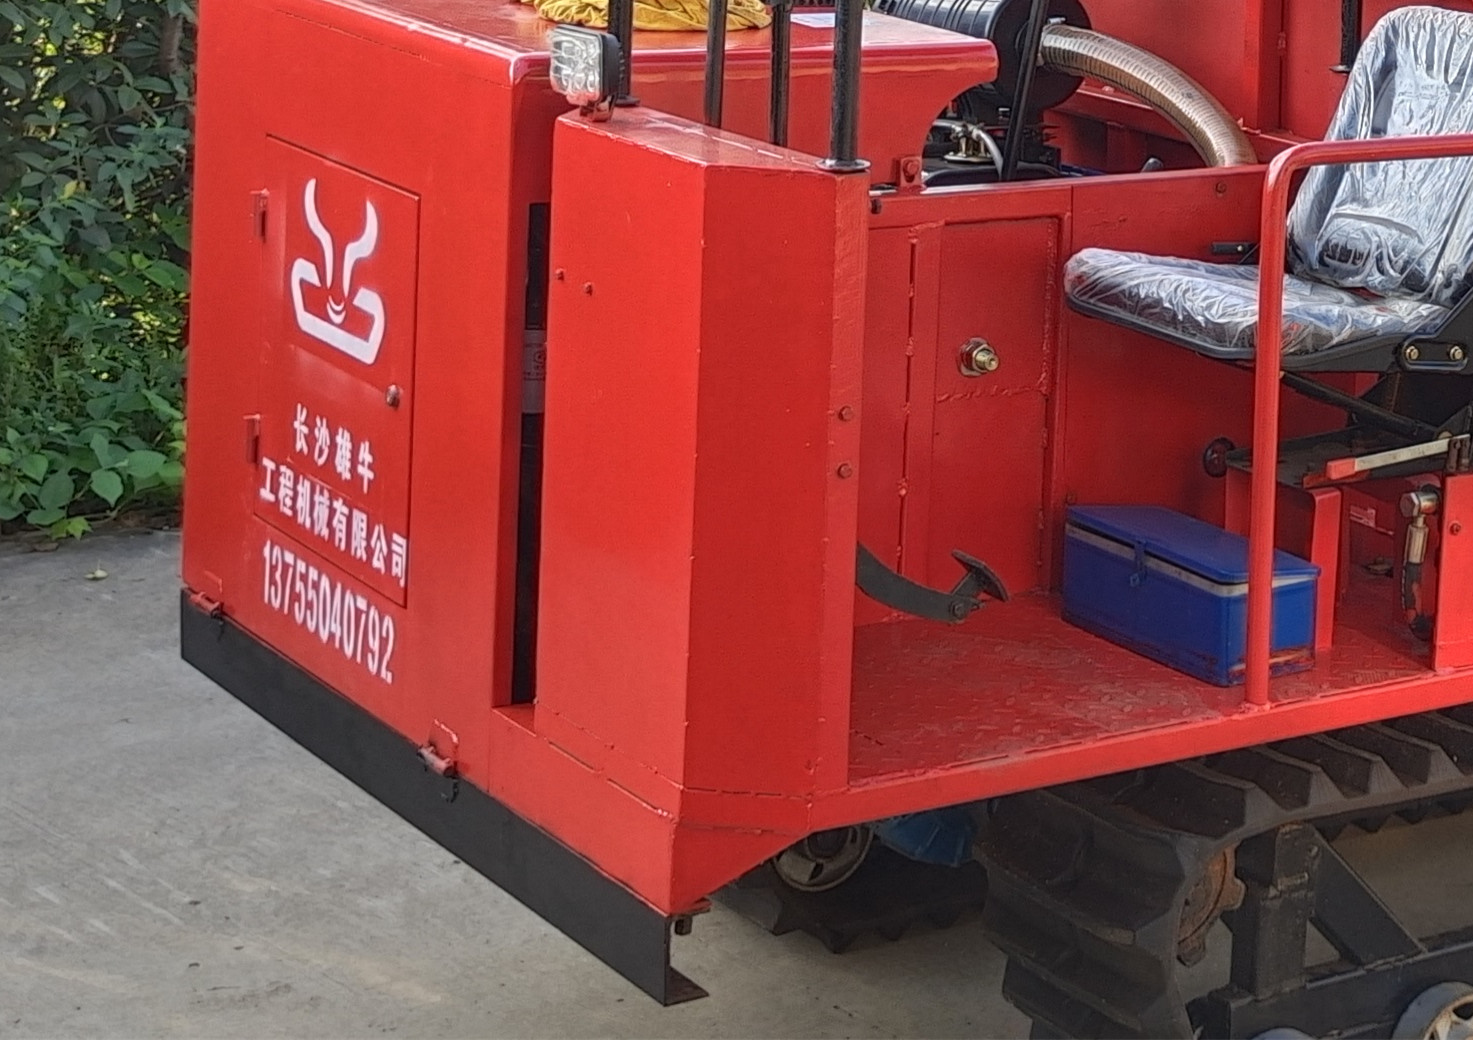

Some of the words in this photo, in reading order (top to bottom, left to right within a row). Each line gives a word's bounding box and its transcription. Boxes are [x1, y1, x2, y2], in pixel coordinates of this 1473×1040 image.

[259, 456, 408, 588] 工程机械有限公司
[262, 539, 396, 684] 13755040792
